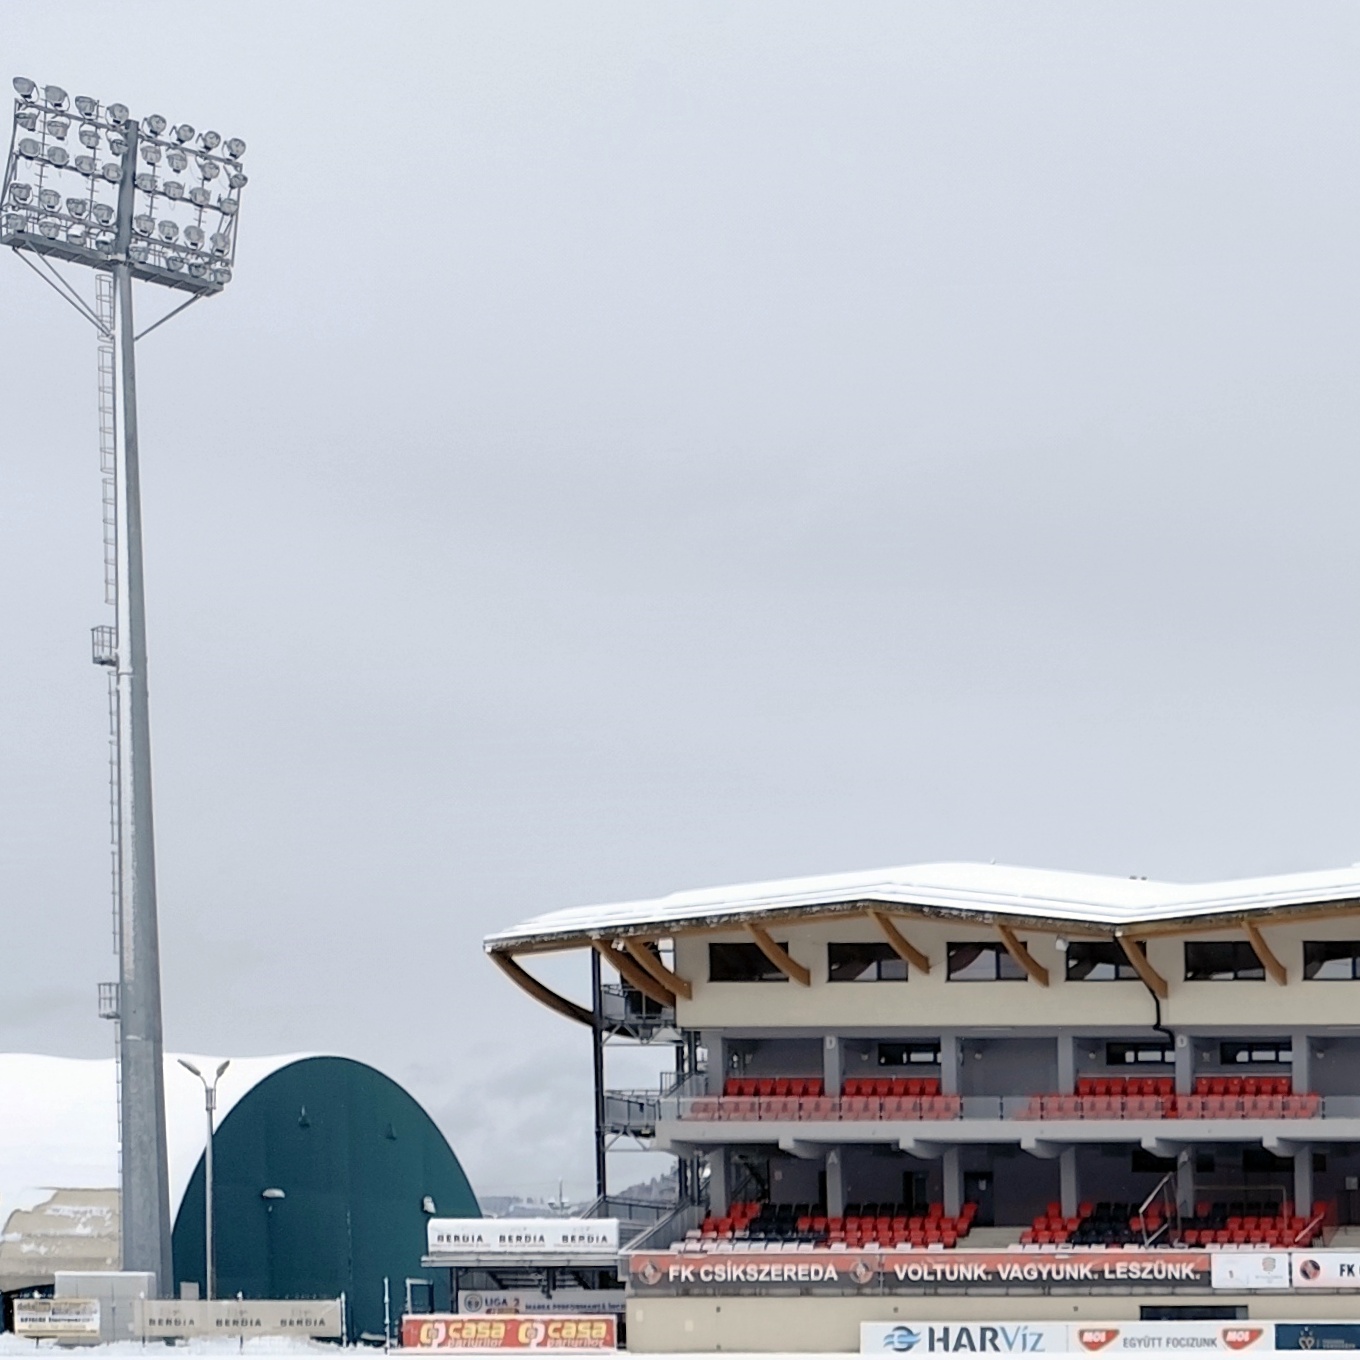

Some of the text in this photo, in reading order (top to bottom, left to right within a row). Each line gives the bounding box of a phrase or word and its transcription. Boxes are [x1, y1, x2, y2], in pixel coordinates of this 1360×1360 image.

[826, 1036, 835, 1049] D
[828, 1151, 838, 1164] A
[668, 1260, 838, 1282] FK CSÍKSZEREDA
[894, 1260, 1200, 1282] VOLTUNK. VAGYUNK. LESZÜNK.
[1340, 1264, 1355, 1277] FK
[485, 1298, 520, 1307] LIGA 2
[448, 1322, 506, 1338] casa
[548, 1322, 607, 1338] casa
[928, 1325, 1045, 1352] HARVíz
[1123, 1335, 1218, 1348] EGYÜTT FOCIZUNK
